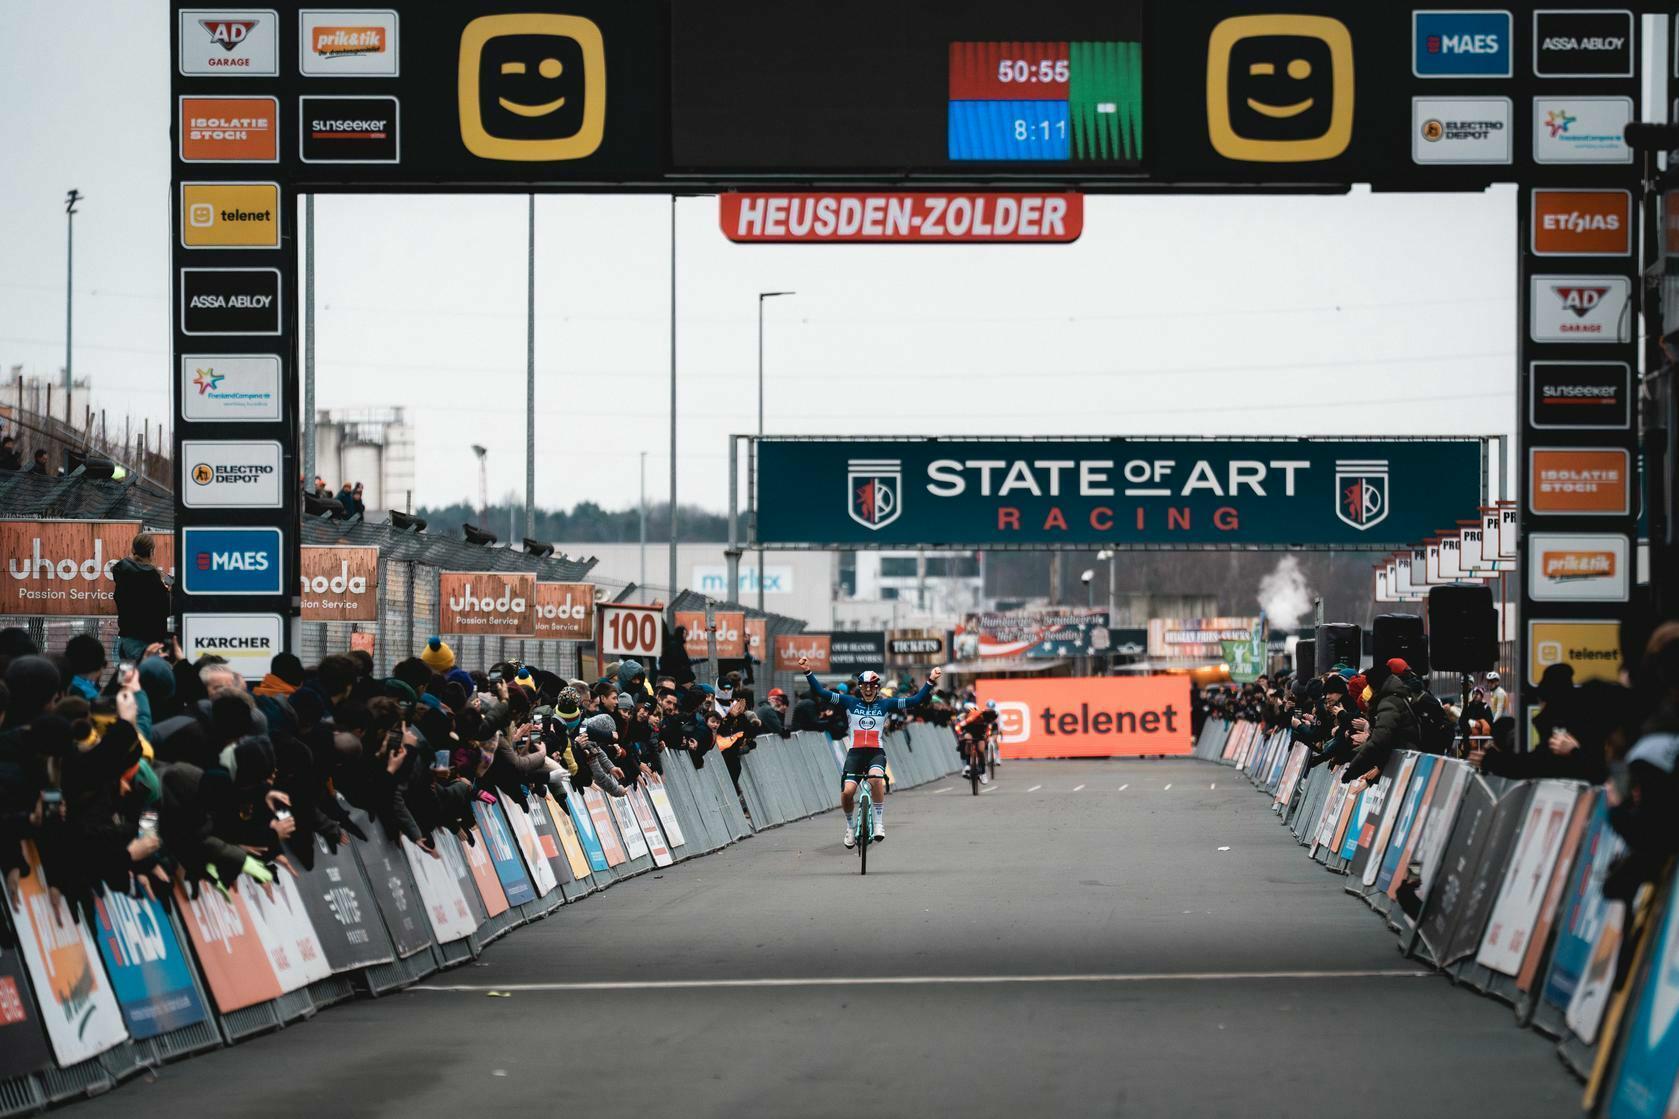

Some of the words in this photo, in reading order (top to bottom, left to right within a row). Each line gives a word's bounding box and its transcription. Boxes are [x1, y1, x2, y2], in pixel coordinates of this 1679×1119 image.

[210, 23, 247, 43] AD
[317, 31, 381, 49] prik&tik
[1442, 35, 1499, 54] MAES
[1542, 38, 1578, 50] ASSA
[1580, 38, 1625, 50] ABLOY
[208, 58, 250, 67] GARAGE
[998, 60, 1070, 83] 50:55
[190, 118, 268, 128] ISOLATIE
[312, 120, 387, 131] sunseeker
[1445, 121, 1504, 131] ELECTRO
[190, 131, 248, 140] STOCK
[1014, 120, 1066, 140] 8:11
[1445, 131, 1490, 140] DEPOT
[221, 209, 271, 222] telenet
[737, 197, 1067, 236] HEUSDEN-ZOLDER
[190, 296, 226, 308] ASSA
[227, 296, 272, 308] ABLOY
[1566, 290, 1599, 310] AD
[1560, 324, 1602, 333] GARAGE
[1543, 386, 1617, 397] sunseeker
[215, 465, 273, 474] ELECTRO
[1540, 470, 1618, 480] ISOLATIE
[215, 475, 260, 484] DEPOT
[926, 459, 1115, 496] STATE
[1124, 460, 1176, 484] OF
[1180, 459, 1311, 496] ART
[997, 507, 1241, 531] RACING
[212, 551, 269, 571] MAES
[18, 587, 66, 599] Passion
[69, 588, 114, 600] Service
[449, 583, 526, 612] uhoda
[321, 600, 358, 609] Service
[456, 616, 487, 625] Passion
[488, 616, 519, 625] Service
[608, 612, 658, 653] 100
[195, 637, 270, 648] KÄRCHER
[893, 640, 938, 654] TICKETS
[1569, 647, 1619, 660] telenet
[1040, 702, 1178, 736] telenet
